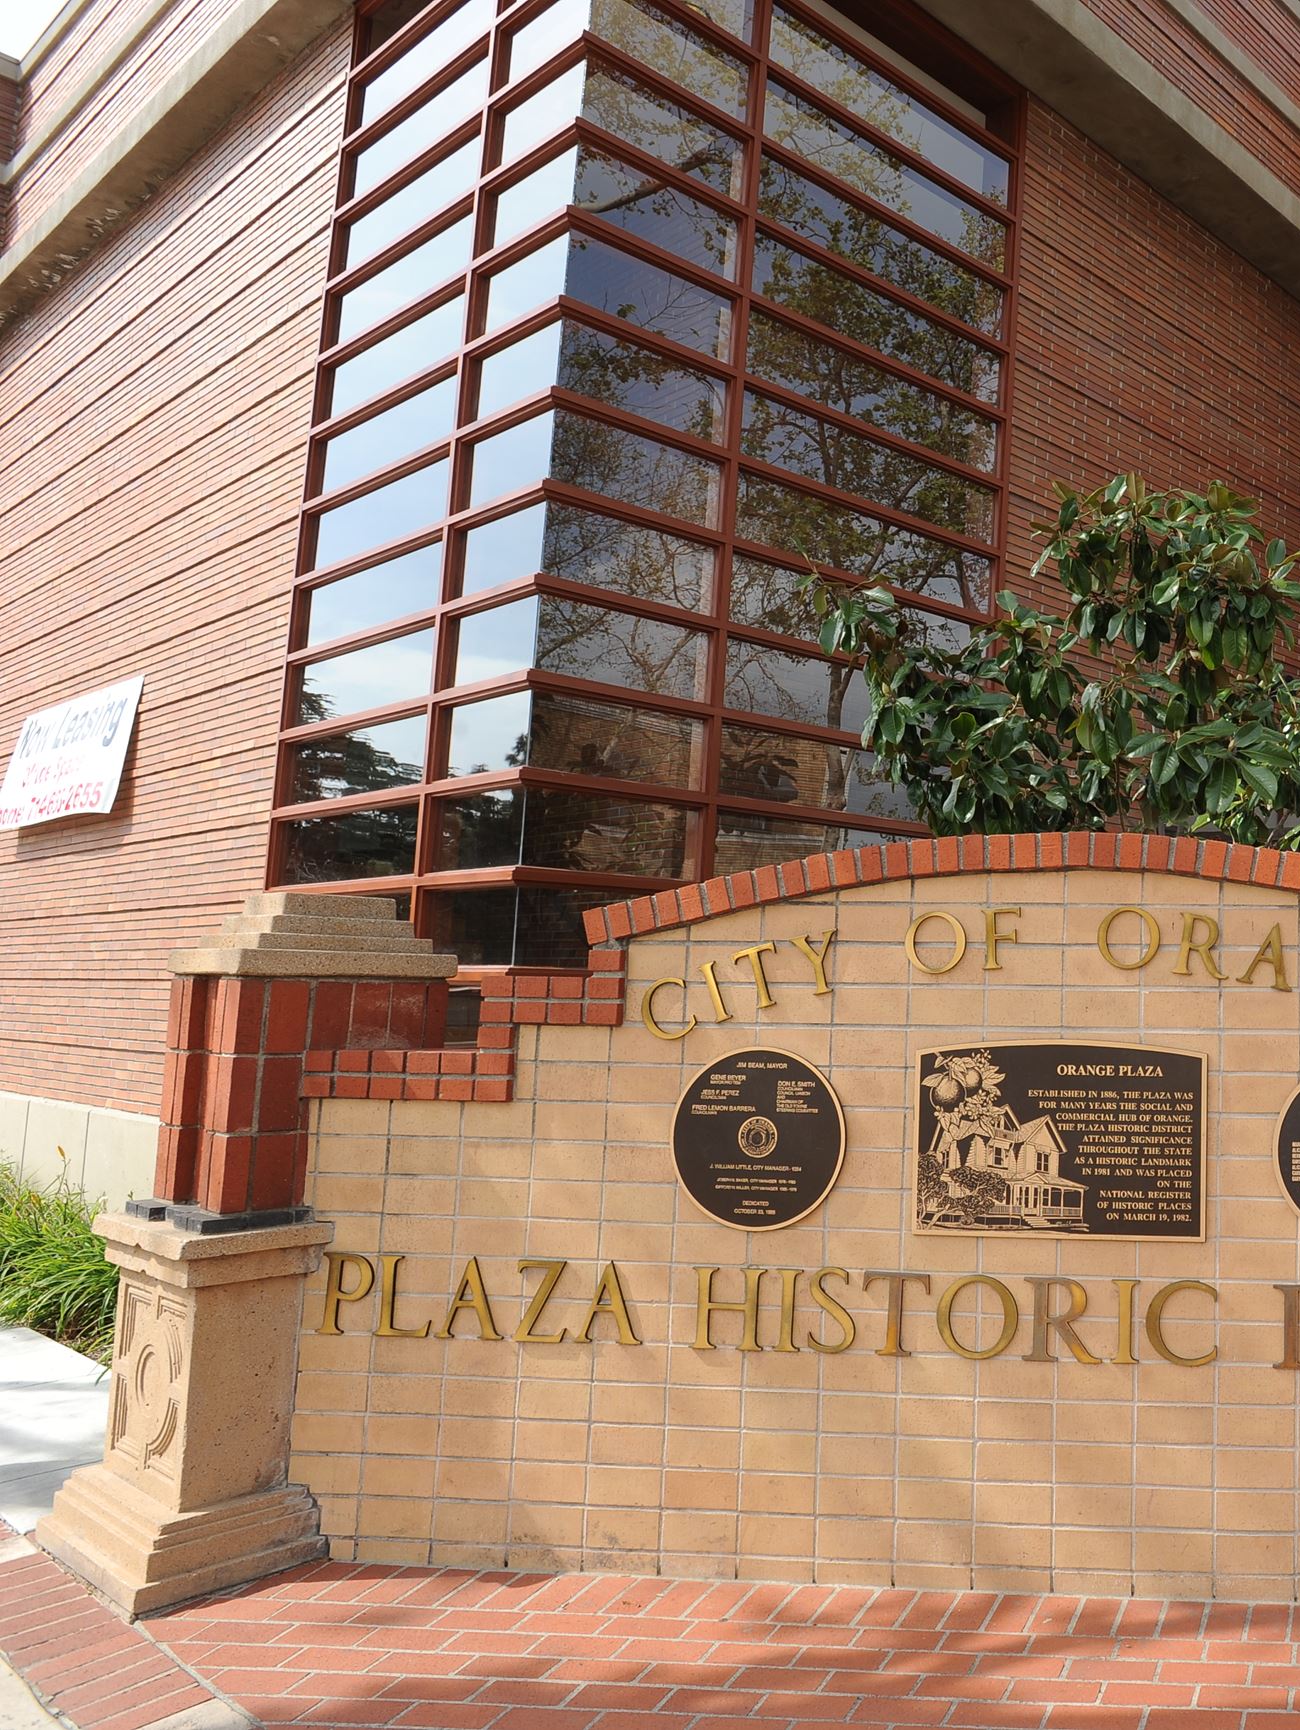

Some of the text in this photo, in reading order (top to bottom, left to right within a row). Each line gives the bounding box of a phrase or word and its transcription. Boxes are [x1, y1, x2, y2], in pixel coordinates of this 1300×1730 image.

[52, 695, 128, 747] Leasing
[640, 928, 837, 1040] CITY
[904, 906, 1022, 975] OF
[1057, 1064, 1163, 1076] ORANGE PLAZA
[1100, 1091, 1119, 1099] 1886,
[1131, 1136, 1192, 1144] SIGNIFICANCE
[315, 1252, 643, 1345] PLAZA
[689, 1267, 1219, 1361] HISTORIC
